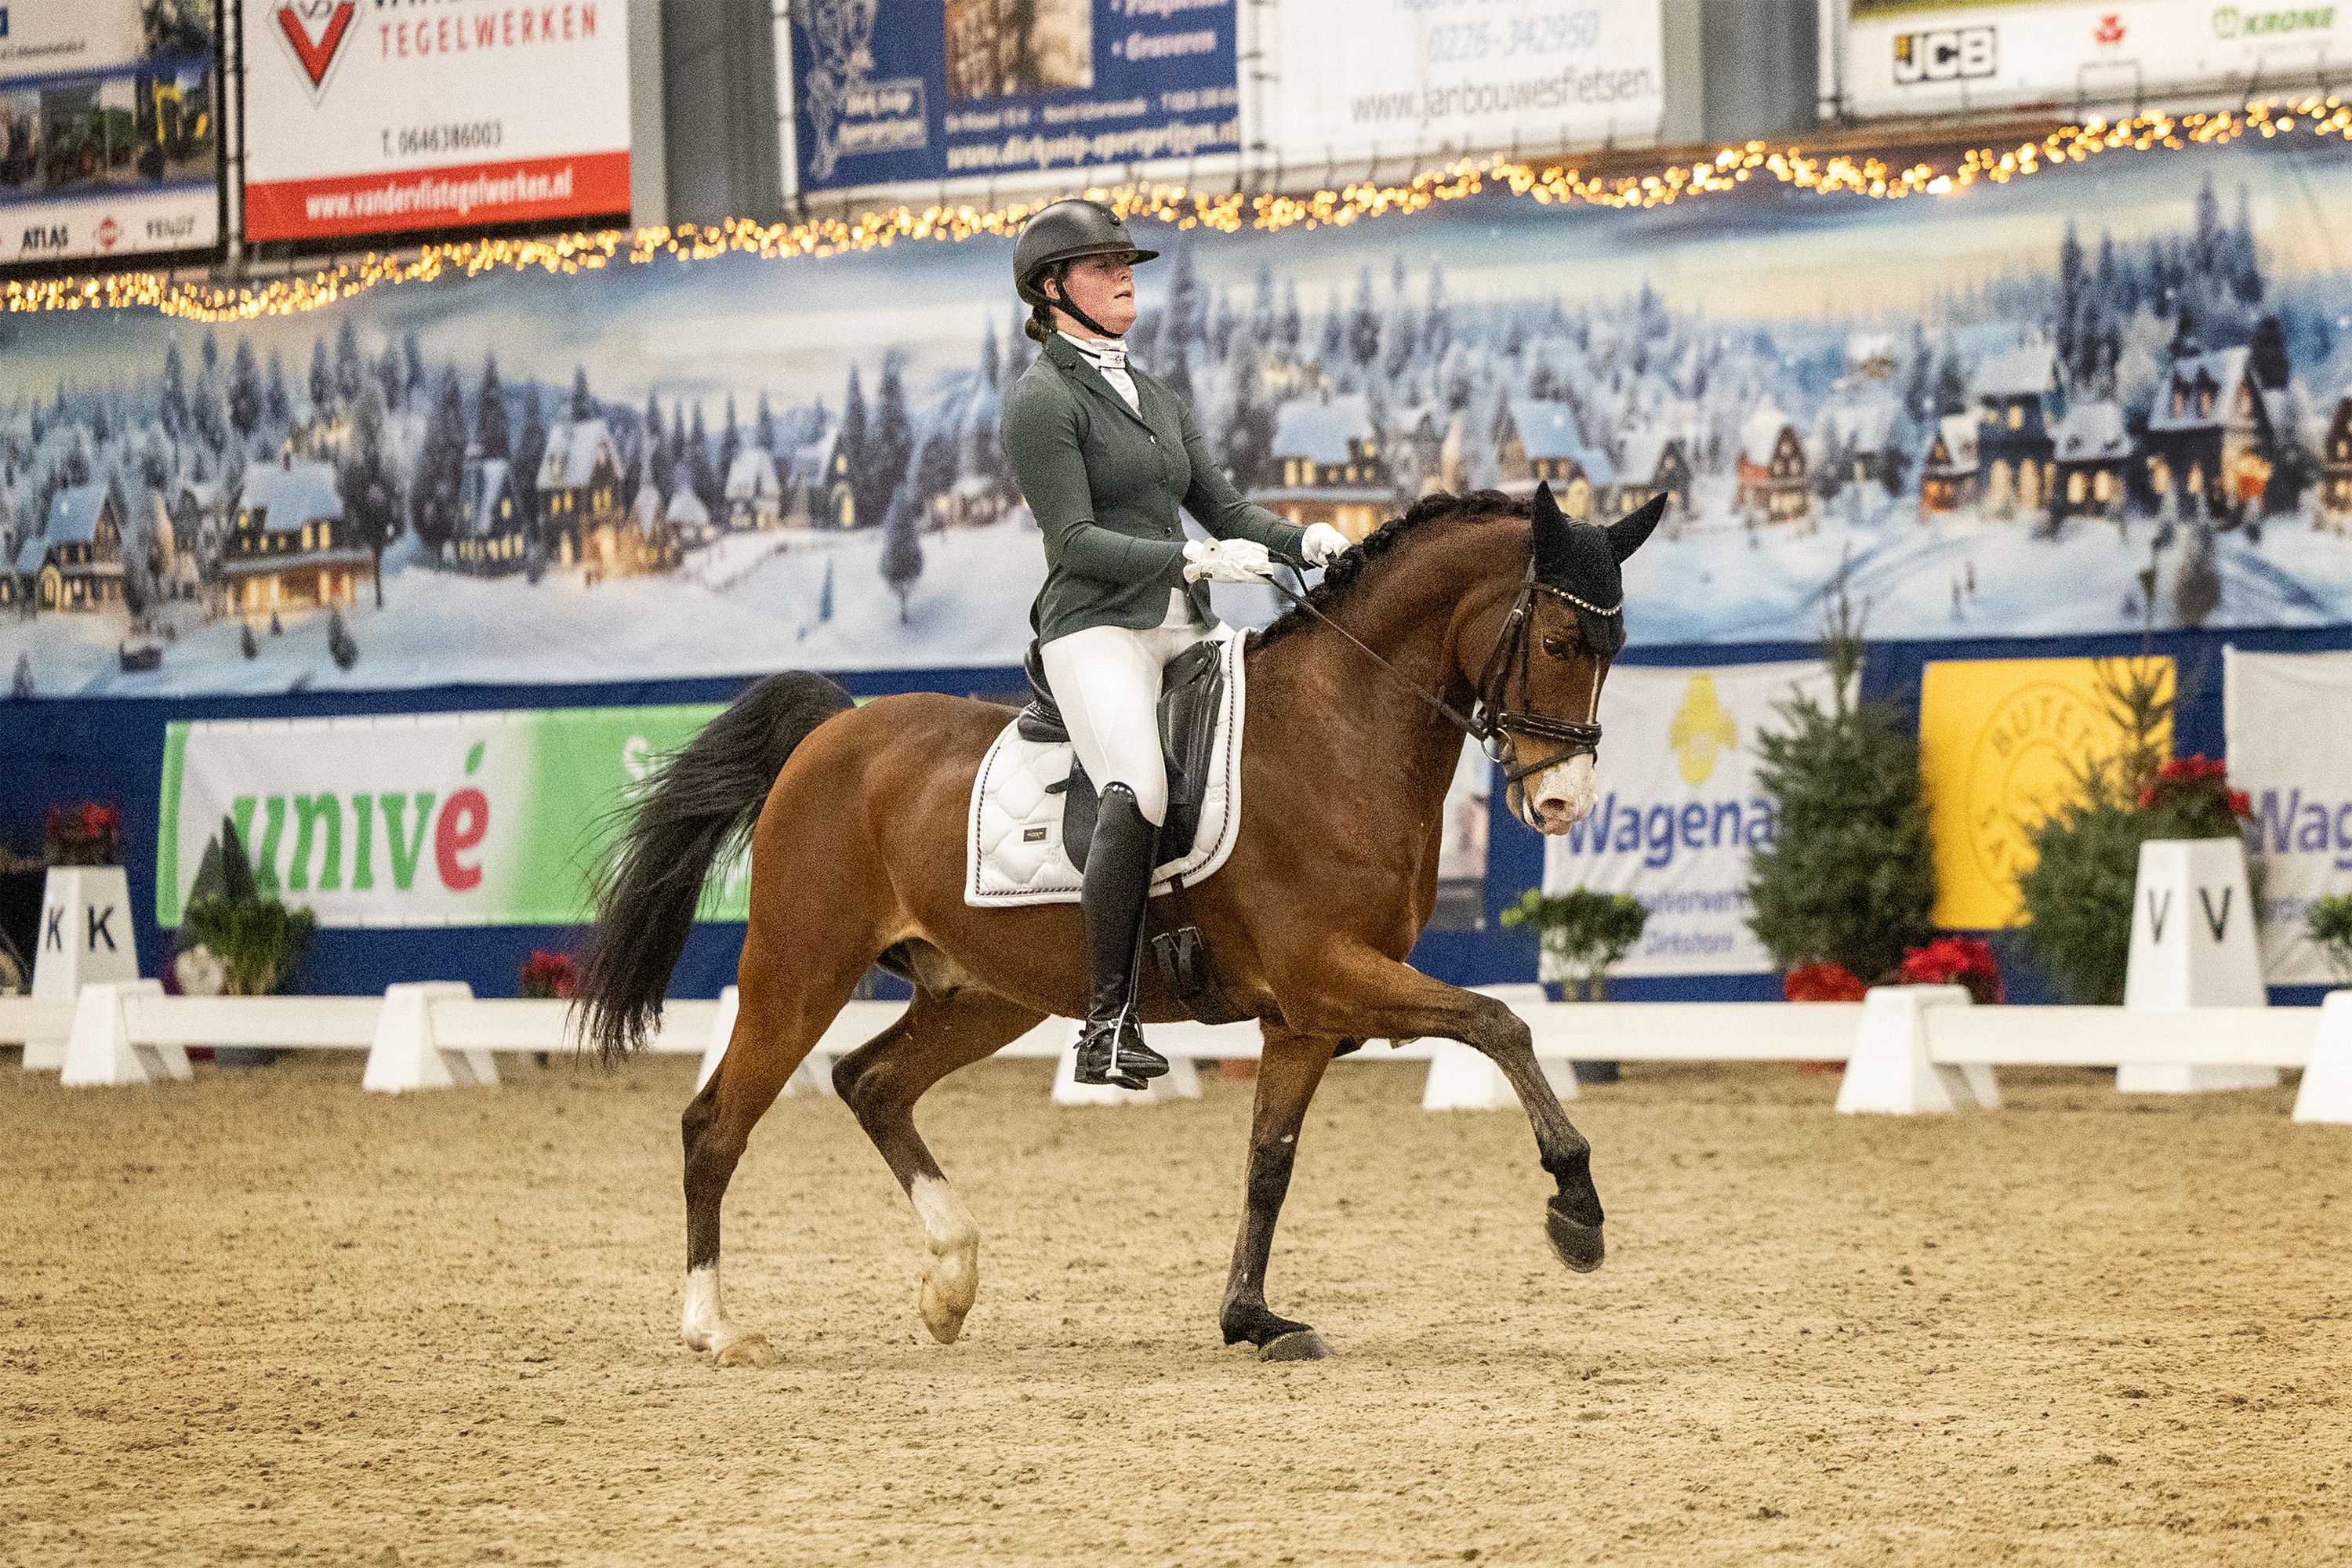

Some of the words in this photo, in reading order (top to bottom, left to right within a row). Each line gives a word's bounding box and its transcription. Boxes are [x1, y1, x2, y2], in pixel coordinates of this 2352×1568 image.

[379, 4, 597, 60] TEGELWERKEN
[2244, 6, 2336, 34] KRONE
[1893, 26, 1997, 85] JCB
[22, 224, 70, 249] ATLAS
[233, 740, 491, 892] univé
[46, 906, 65, 953] K
[87, 904, 115, 951] K
[2148, 889, 2170, 946] V
[2198, 886, 2231, 942] V
